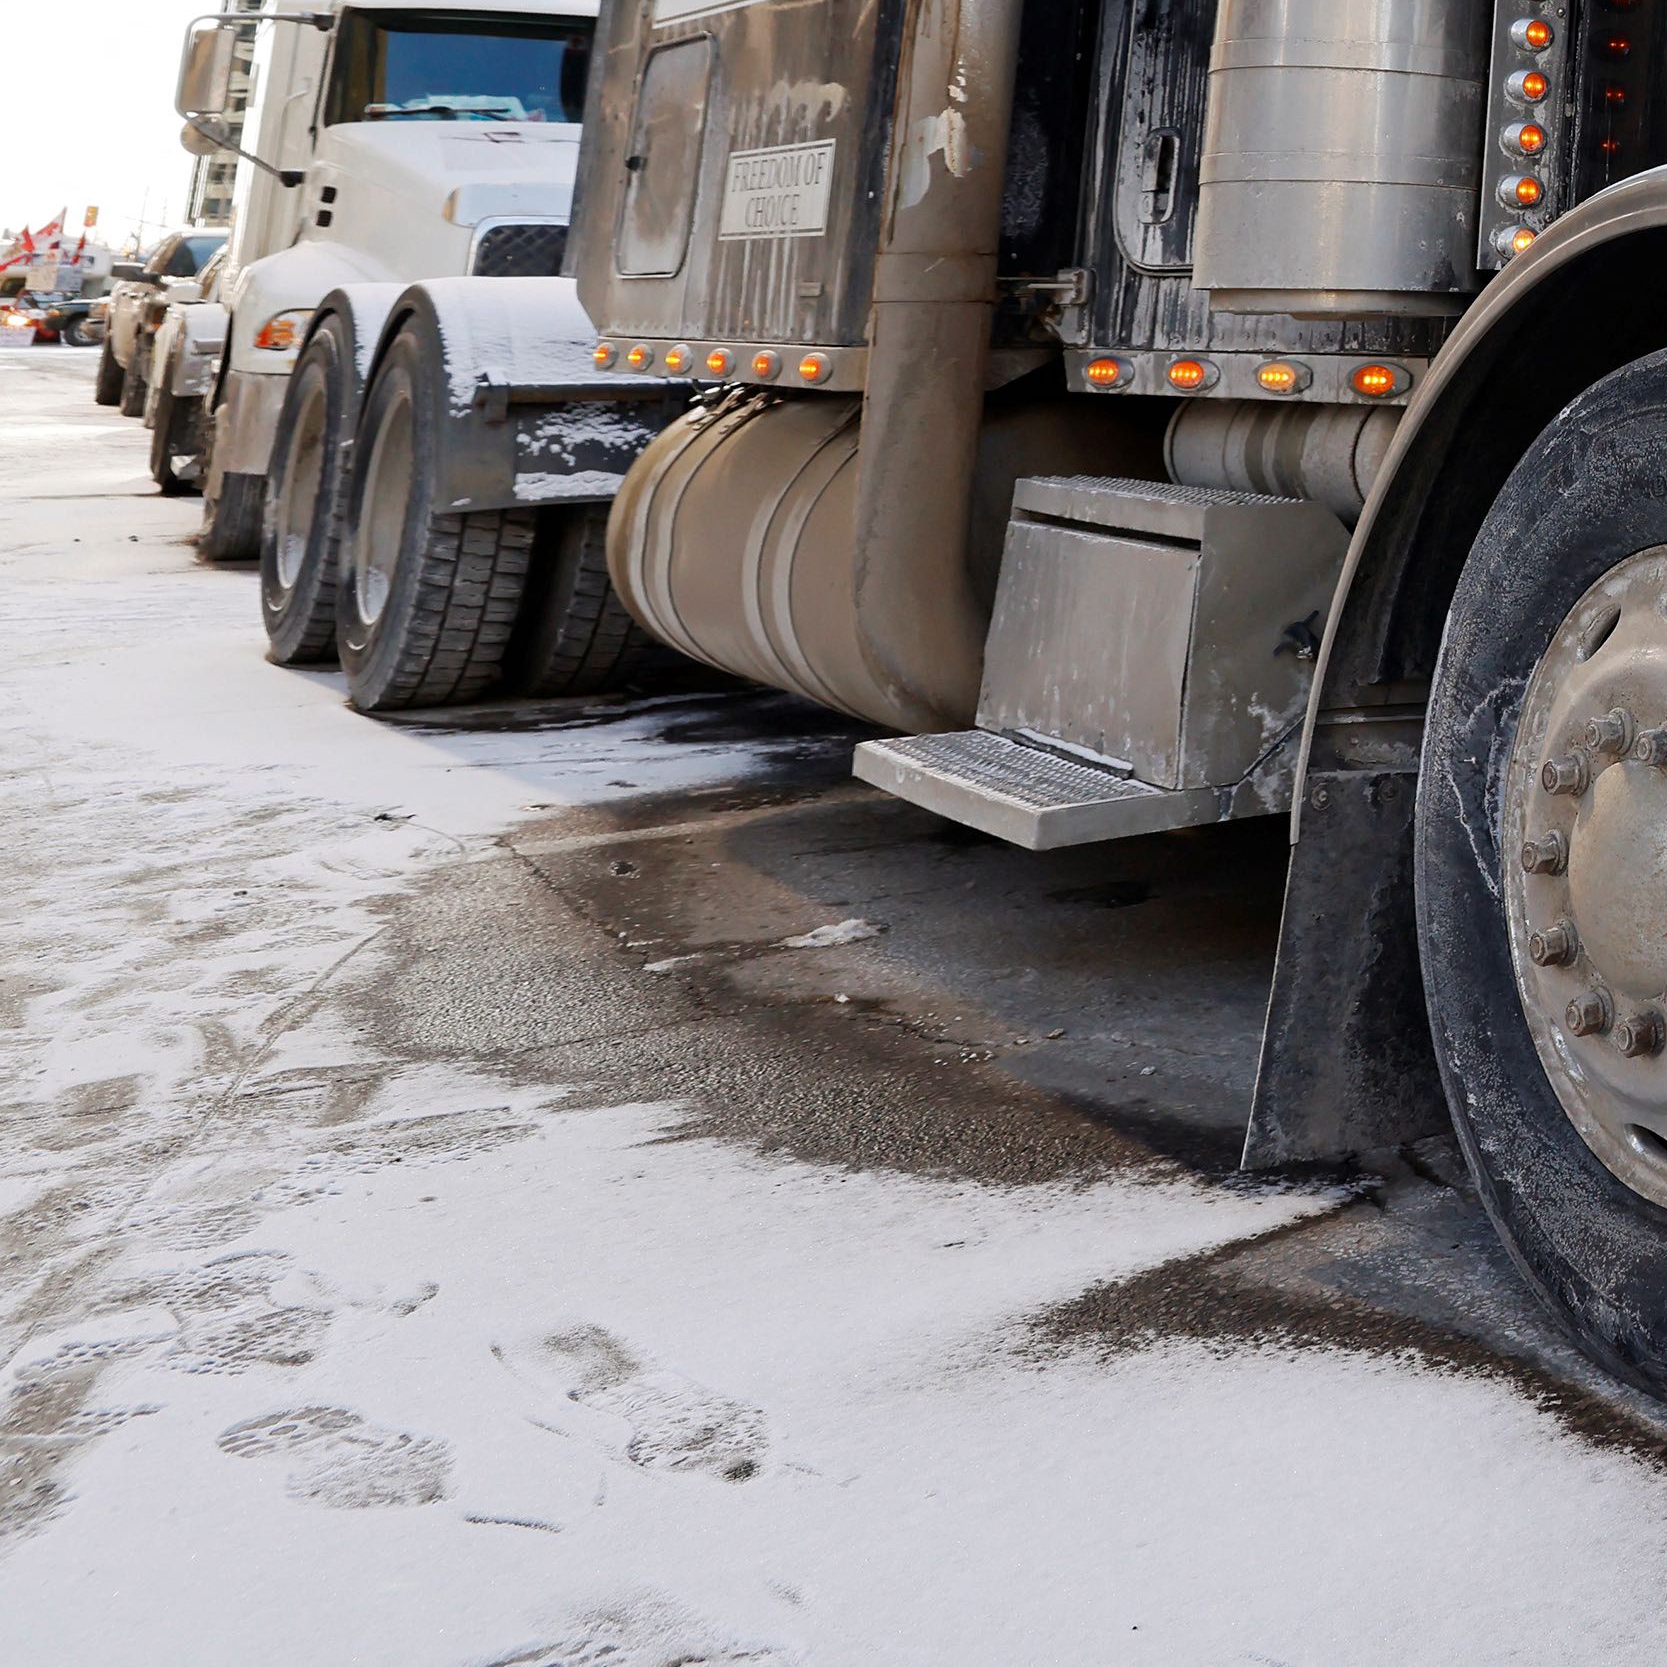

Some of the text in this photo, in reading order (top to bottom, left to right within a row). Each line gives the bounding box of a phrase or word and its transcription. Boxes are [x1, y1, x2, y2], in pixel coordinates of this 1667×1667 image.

[731, 152, 826, 192] FREEDOM OF
[744, 194, 801, 227] CHOICE
